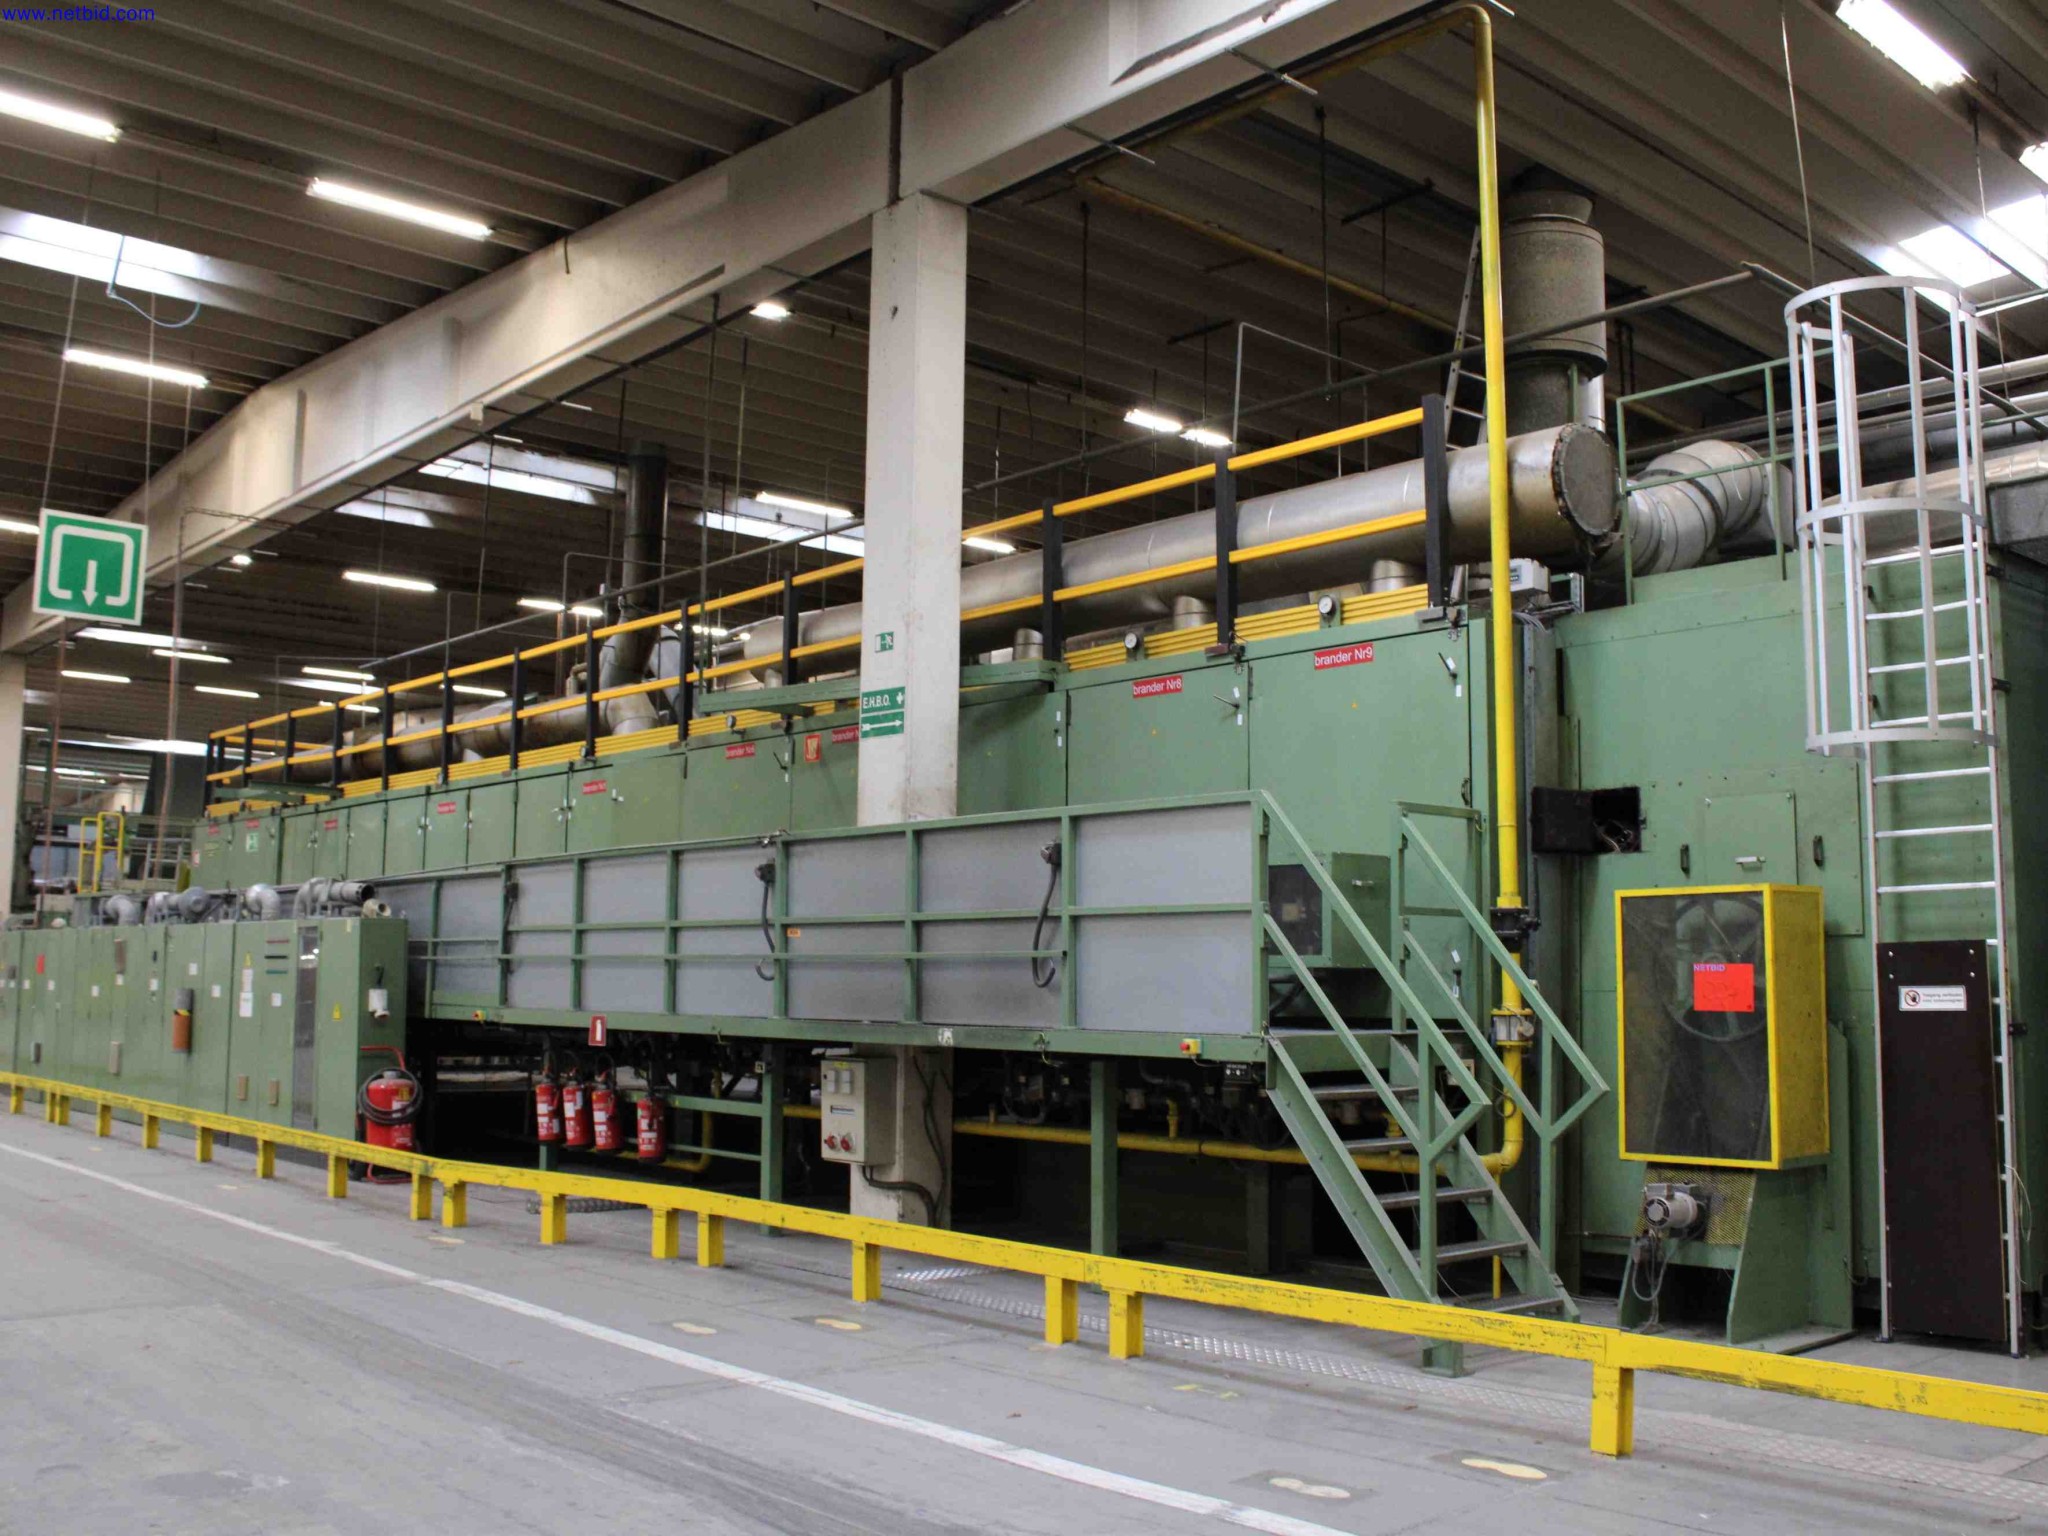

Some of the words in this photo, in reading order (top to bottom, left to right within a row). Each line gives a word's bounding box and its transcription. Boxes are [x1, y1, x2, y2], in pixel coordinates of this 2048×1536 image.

[1314, 651, 1352, 666] brander
[1354, 646, 1373, 660] Nr9
[1133, 681, 1164, 695] brander
[1166, 678, 1182, 690] Nr8
[862, 694, 891, 709] E.H.B.O.
[1693, 963, 1726, 972] NETBID
